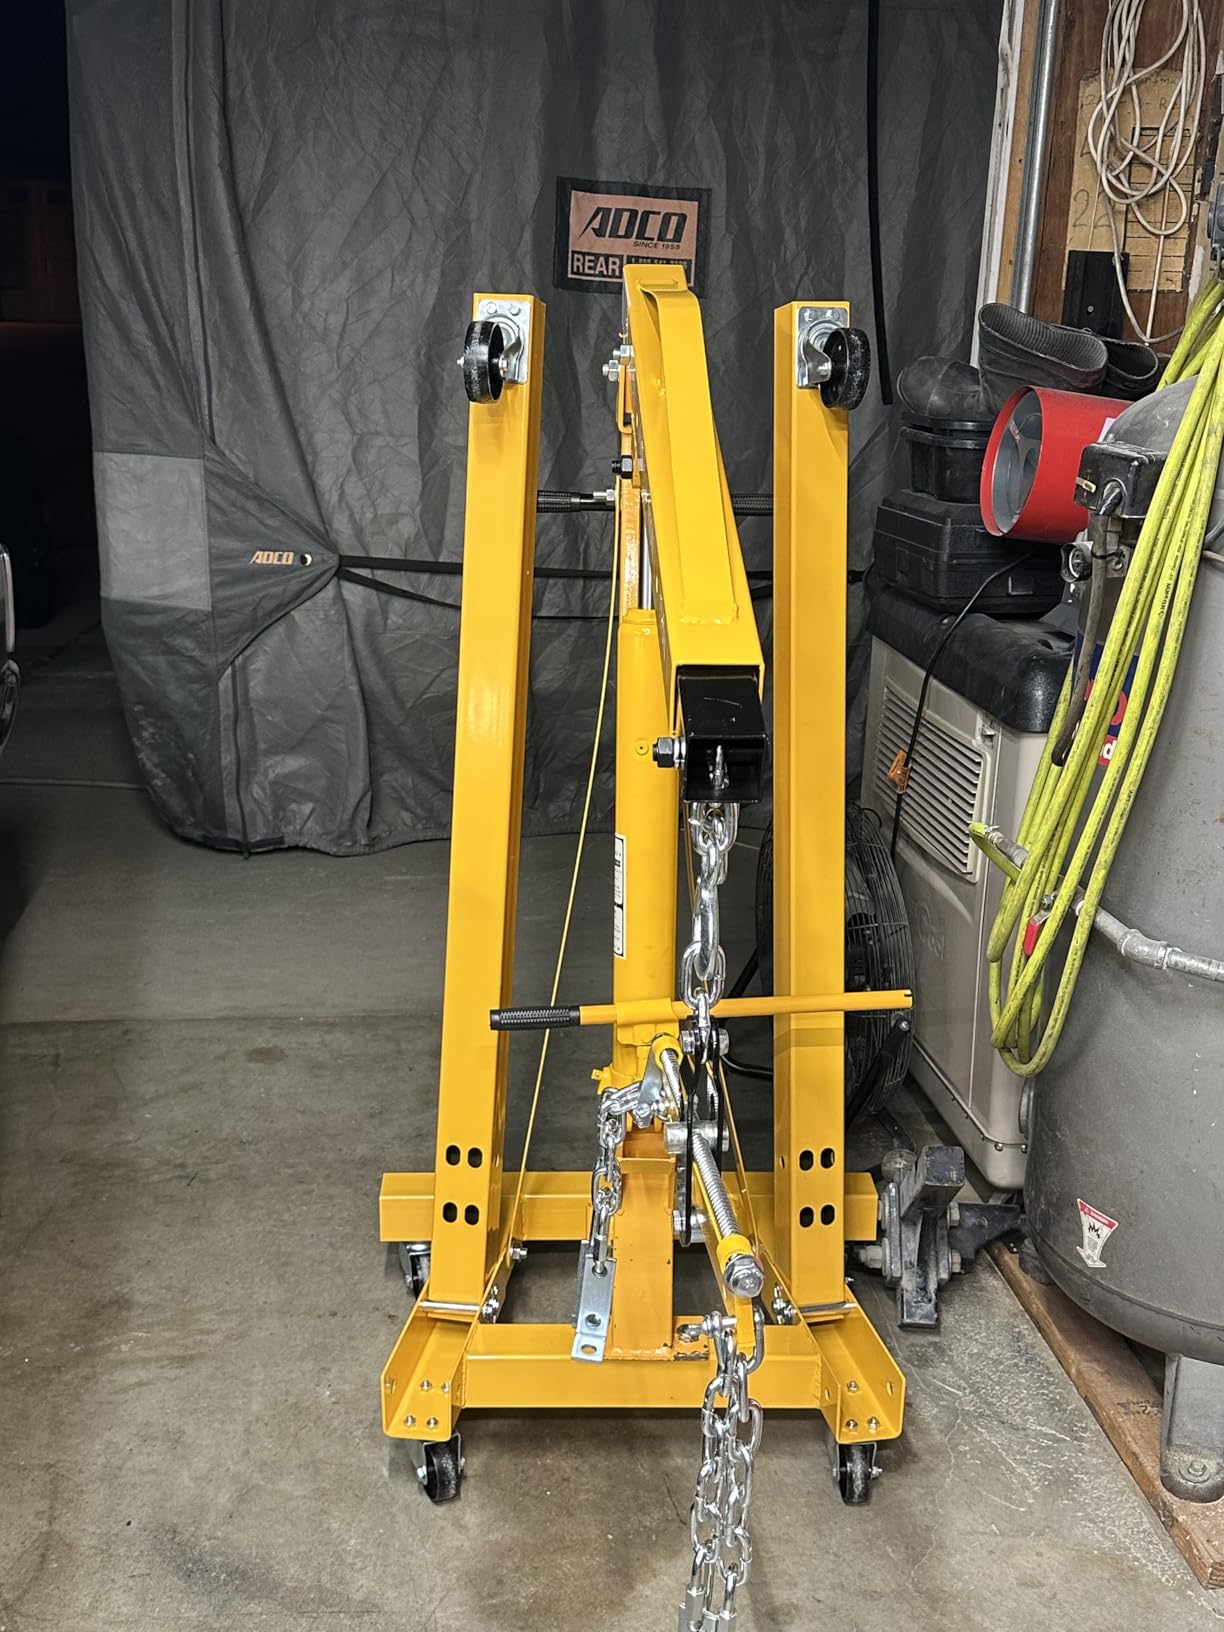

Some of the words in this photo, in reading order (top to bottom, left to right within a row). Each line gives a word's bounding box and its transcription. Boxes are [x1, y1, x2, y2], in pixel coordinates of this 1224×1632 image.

[578, 207, 687, 242] ADCO
[633, 241, 659, 249] SINCE
[661, 243, 680, 251] 1955
[573, 254, 620, 276] REAR
[249, 551, 294, 565] ADCO
